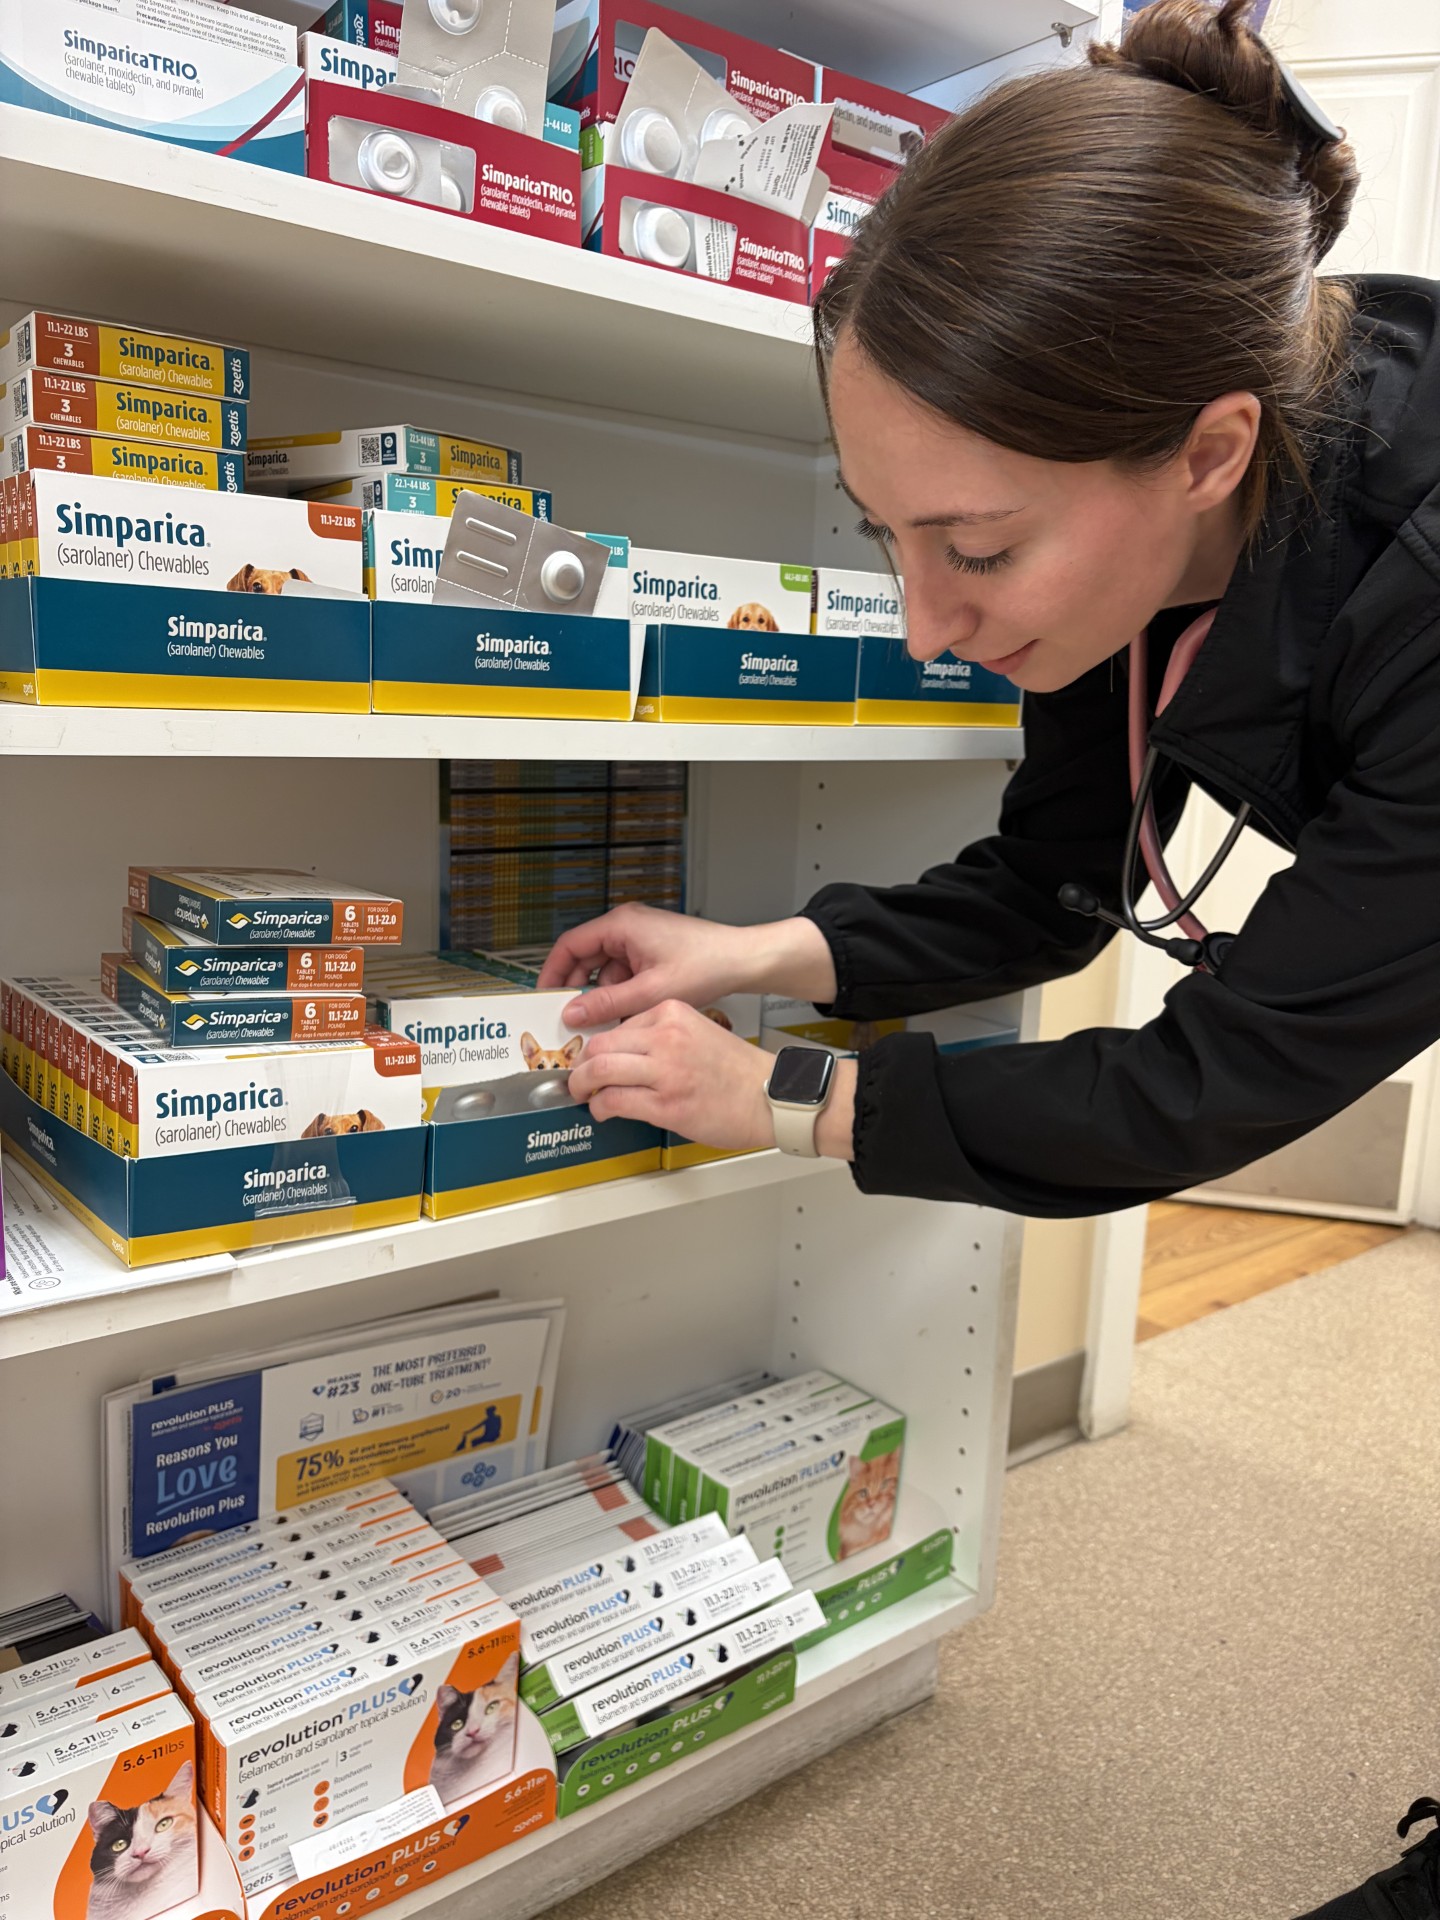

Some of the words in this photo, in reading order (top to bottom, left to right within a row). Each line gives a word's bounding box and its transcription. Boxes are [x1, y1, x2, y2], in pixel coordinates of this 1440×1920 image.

[64, 51, 107, 76] (sarolaner,
[108, 65, 155, 89] moxidectin,
[155, 79, 171, 91] and
[172, 82, 204, 100] pyrantel
[65, 66, 104, 87] chewable
[105, 76, 136, 97] tablets)
[481, 164, 574, 205] SimparicaTRIO
[480, 183, 512, 203] (sarolaner,
[544, 203, 555, 213] and
[555, 204, 577, 221] pyrantel
[739, 237, 805, 271] SimparicaTRIO
[47, 320, 74, 336] 11.1-22
[74, 325, 89, 339] LBS
[52, 356, 85, 369] CHEWABLES
[64, 342, 75, 358] 3
[118, 337, 211, 371] Simparica
[43, 376, 70, 392] 11.1-22
[71, 381, 86, 394] LBS
[118, 362, 167, 384] (sarolaner)
[167, 369, 213, 390] Chewables
[232, 357, 246, 396] zoetis
[50, 412, 83, 425] CHEWABLES
[60, 398, 71, 413] 3
[116, 391, 208, 424] Simparica
[38, 433, 65, 448] 11.1-22
[66, 437, 82, 450] LBS
[116, 415, 164, 437] (sarolaner)
[165, 421, 211, 442] Chewables
[230, 409, 243, 447] zoetis
[56, 455, 67, 470] 3
[111, 446, 204, 476] Simparica
[449, 444, 502, 471] Simparica
[408, 496, 417, 509] 3
[55, 501, 206, 549] Simparica
[320, 513, 343, 527] 11.1-22
[343, 516, 356, 528] LBS
[57, 542, 134, 573] (sarolaner)
[138, 550, 210, 577] Chewables
[632, 570, 718, 602] Simparica
[631, 601, 676, 620] (sarolaner)
[677, 603, 720, 622] Chewables
[826, 589, 899, 617] Simparica
[167, 614, 264, 642] Simparica
[167, 640, 217, 659] (sarolaner)
[218, 644, 265, 661] Chewables
[476, 632, 550, 658] Simparica
[474, 656, 513, 671] (sarolaner)
[514, 658, 551, 672] Chewables
[740, 652, 798, 675] Simparica
[344, 905, 356, 922] 6
[367, 914, 397, 925] 11.1-22.0
[300, 952, 313, 969] 6
[325, 961, 357, 972] 11.1-22.0
[304, 1002, 317, 1019] 6
[328, 1010, 359, 1021] 11.1-22.0
[404, 1016, 507, 1049] Simparica
[384, 1055, 405, 1067] 11.1-22
[404, 1054, 417, 1066] LBS
[155, 1081, 284, 1121] Simparica
[154, 1122, 221, 1147] (sarolaner)
[224, 1114, 287, 1137] Chewables
[526, 1123, 593, 1150] Simparica
[525, 1146, 560, 1164] (sarolaner)
[560, 1140, 593, 1156] Chewables
[243, 1161, 327, 1190] Simparica
[242, 1190, 285, 1207] (sarolaner)
[286, 1183, 328, 1199] Chewables
[372, 1363, 393, 1378] THE
[394, 1356, 427, 1373] MOST
[427, 1343, 487, 1367] PREFERRED
[326, 1372, 362, 1385] REASON
[326, 1380, 361, 1399] #23
[370, 1372, 427, 1396] ONE-TUBE
[151, 1408, 207, 1431] revolution
[207, 1399, 235, 1415] PLUS
[156, 1440, 212, 1469] Reasons
[214, 1434, 239, 1450] You
[296, 1449, 345, 1481] 75%
[156, 1454, 238, 1505] Love
[145, 1505, 215, 1537] Revolution
[217, 1494, 246, 1514] Plus
[158, 1580, 227, 1609] revolution
[227, 1565, 261, 1584] PLUS
[170, 1600, 241, 1630] revolution
[241, 1586, 277, 1604] PLUS
[530, 1609, 590, 1642] revolution
[588, 1596, 618, 1617] PLUS
[184, 1621, 256, 1654] revolution
[256, 1607, 292, 1625] PLUS
[92, 1651, 102, 1660] 6
[198, 1643, 270, 1676] revolution
[270, 1627, 307, 1647] PLUS
[563, 1637, 623, 1673] revolution
[622, 1625, 651, 1646] PLUS
[18, 1662, 60, 1683] 5.6-11
[59, 1655, 81, 1668] lbs
[212, 1666, 286, 1701] revolution
[286, 1650, 323, 1671] PLUS
[110, 1686, 121, 1695] 6
[228, 1690, 303, 1728] revolution
[303, 1672, 341, 1695] PLUS
[591, 1676, 653, 1712] revolution
[652, 1662, 682, 1684] PLUS
[35, 1698, 77, 1720] 5.6-11
[76, 1691, 100, 1704] lbs
[232, 1712, 272, 1735] (selamectin
[273, 1706, 287, 1716] and
[287, 1694, 319, 1711] sarolaner
[319, 1685, 341, 1699] topical
[341, 1672, 369, 1690] solution)
[131, 1721, 142, 1731] 6
[238, 1713, 344, 1769] revolution
[348, 1686, 398, 1720] PLUS
[238, 1754, 294, 1784] (selamectin
[295, 1741, 314, 1757] and
[314, 1722, 360, 1751] sarolaner
[360, 1710, 389, 1730] topical
[389, 1689, 428, 1716] solution)
[580, 1726, 669, 1771] revolution
[671, 1703, 712, 1733] PLUS
[53, 1734, 97, 1757] 5.6-11
[96, 1725, 119, 1739] lbs
[122, 1746, 164, 1772] 5.6-11
[164, 1740, 185, 1756] lbs
[339, 1750, 348, 1763] 3
[333, 1762, 374, 1786] Roundworms
[333, 1779, 370, 1801] Hookworms
[259, 1804, 278, 1819] Fleas
[332, 1794, 370, 1817] Heartworms
[29, 1807, 77, 1839] solution)
[259, 1821, 277, 1834] Ticks
[258, 1838, 271, 1851] Ear
[270, 1831, 289, 1846] mites
[274, 1857, 387, 1916] revolution
[391, 1830, 441, 1866] PLUS
